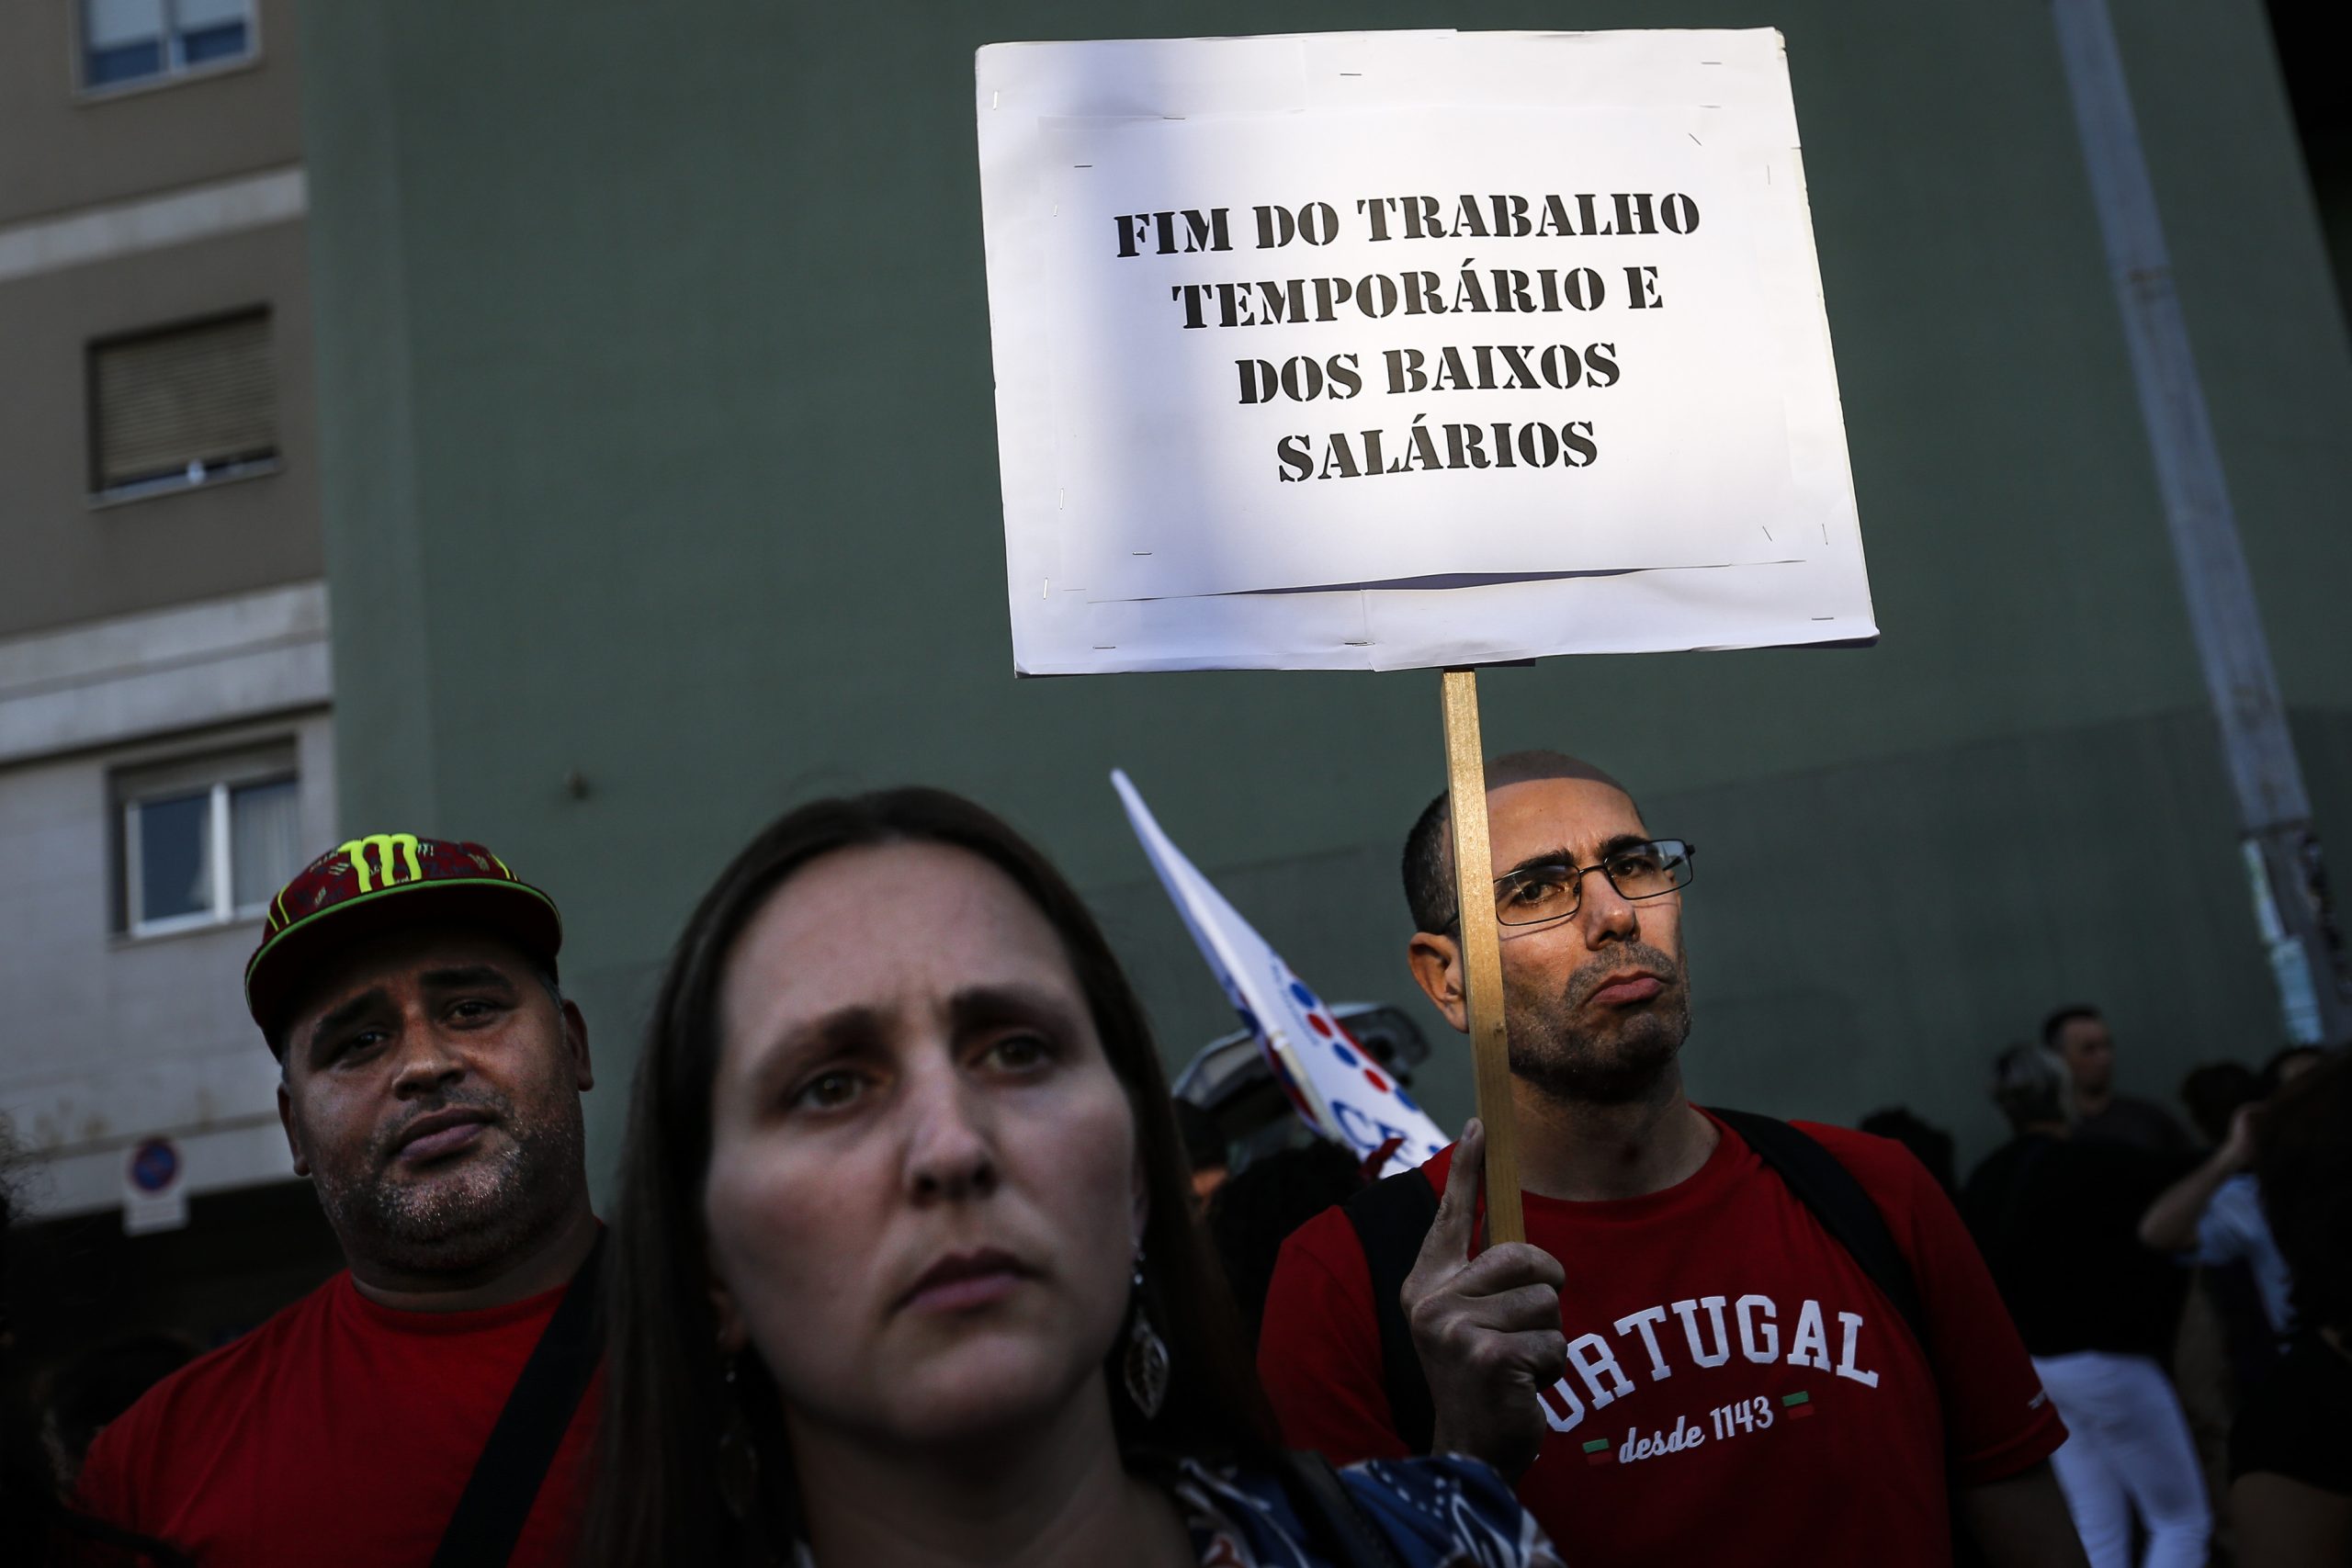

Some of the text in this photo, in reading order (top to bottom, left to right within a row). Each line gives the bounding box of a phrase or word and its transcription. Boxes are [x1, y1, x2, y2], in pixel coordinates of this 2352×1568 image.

[1113, 193, 1700, 258] FIM DO TRABALHO
[1171, 257, 1664, 330] TEMPORÁRIO E
[1234, 343, 1621, 405] DOS BAIXOS
[1277, 412, 1598, 483] SALÁRIOS
[1535, 1294, 1879, 1433] ORTUGAL
[1619, 1395, 1773, 1463] desde 1143
